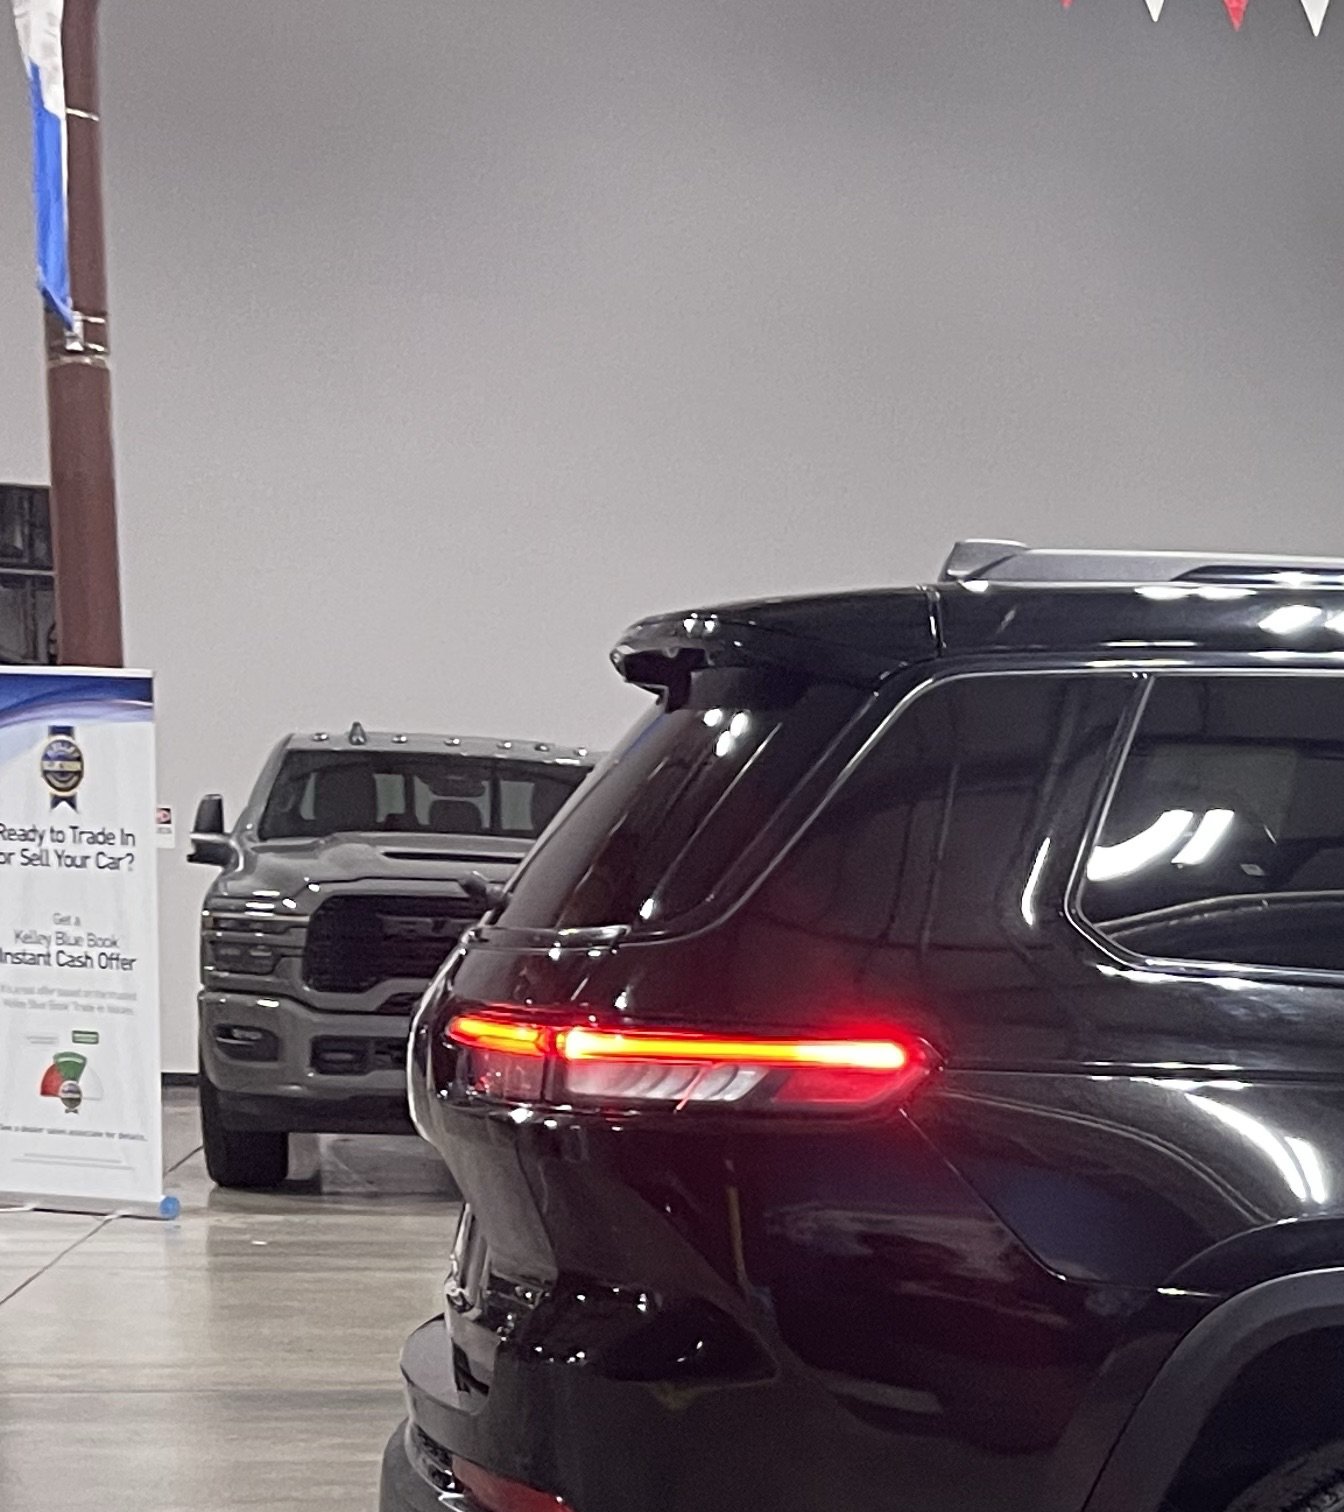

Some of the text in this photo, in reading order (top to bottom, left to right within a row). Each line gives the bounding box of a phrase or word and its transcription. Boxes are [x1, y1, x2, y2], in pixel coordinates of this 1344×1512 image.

[0, 823, 136, 847] Ready to Trade In
[20, 848, 50, 867] Sell
[54, 850, 90, 869] Your
[96, 851, 135, 872] Car?
[55, 931, 85, 947] Blue
[87, 932, 120, 948] Book
[0, 948, 137, 971] Instant Cash Offer
